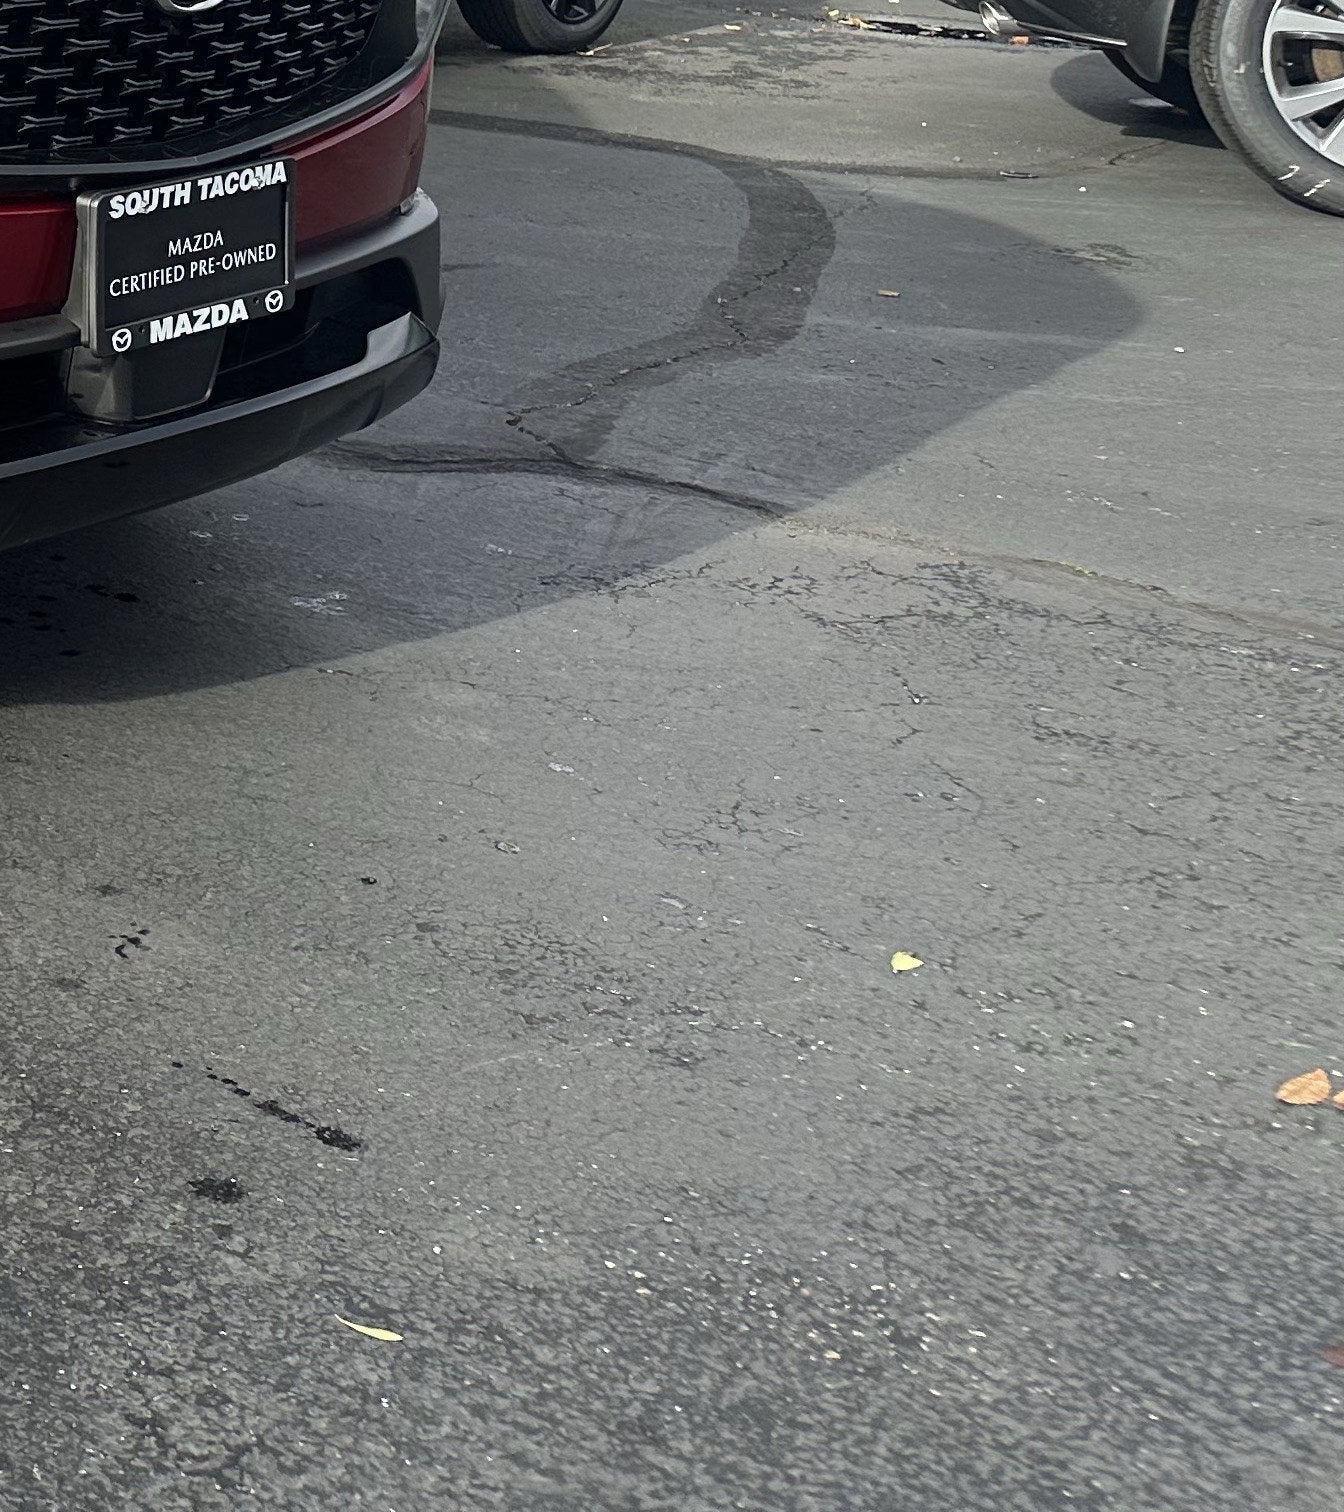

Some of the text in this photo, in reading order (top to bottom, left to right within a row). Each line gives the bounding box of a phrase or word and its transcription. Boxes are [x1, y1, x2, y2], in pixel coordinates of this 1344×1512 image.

[108, 161, 288, 220] SOUTH TACOMA
[167, 230, 224, 258] MAZDA
[108, 243, 277, 298] CERTIFIED PRE-OWNED
[149, 298, 249, 344] MAZDA
